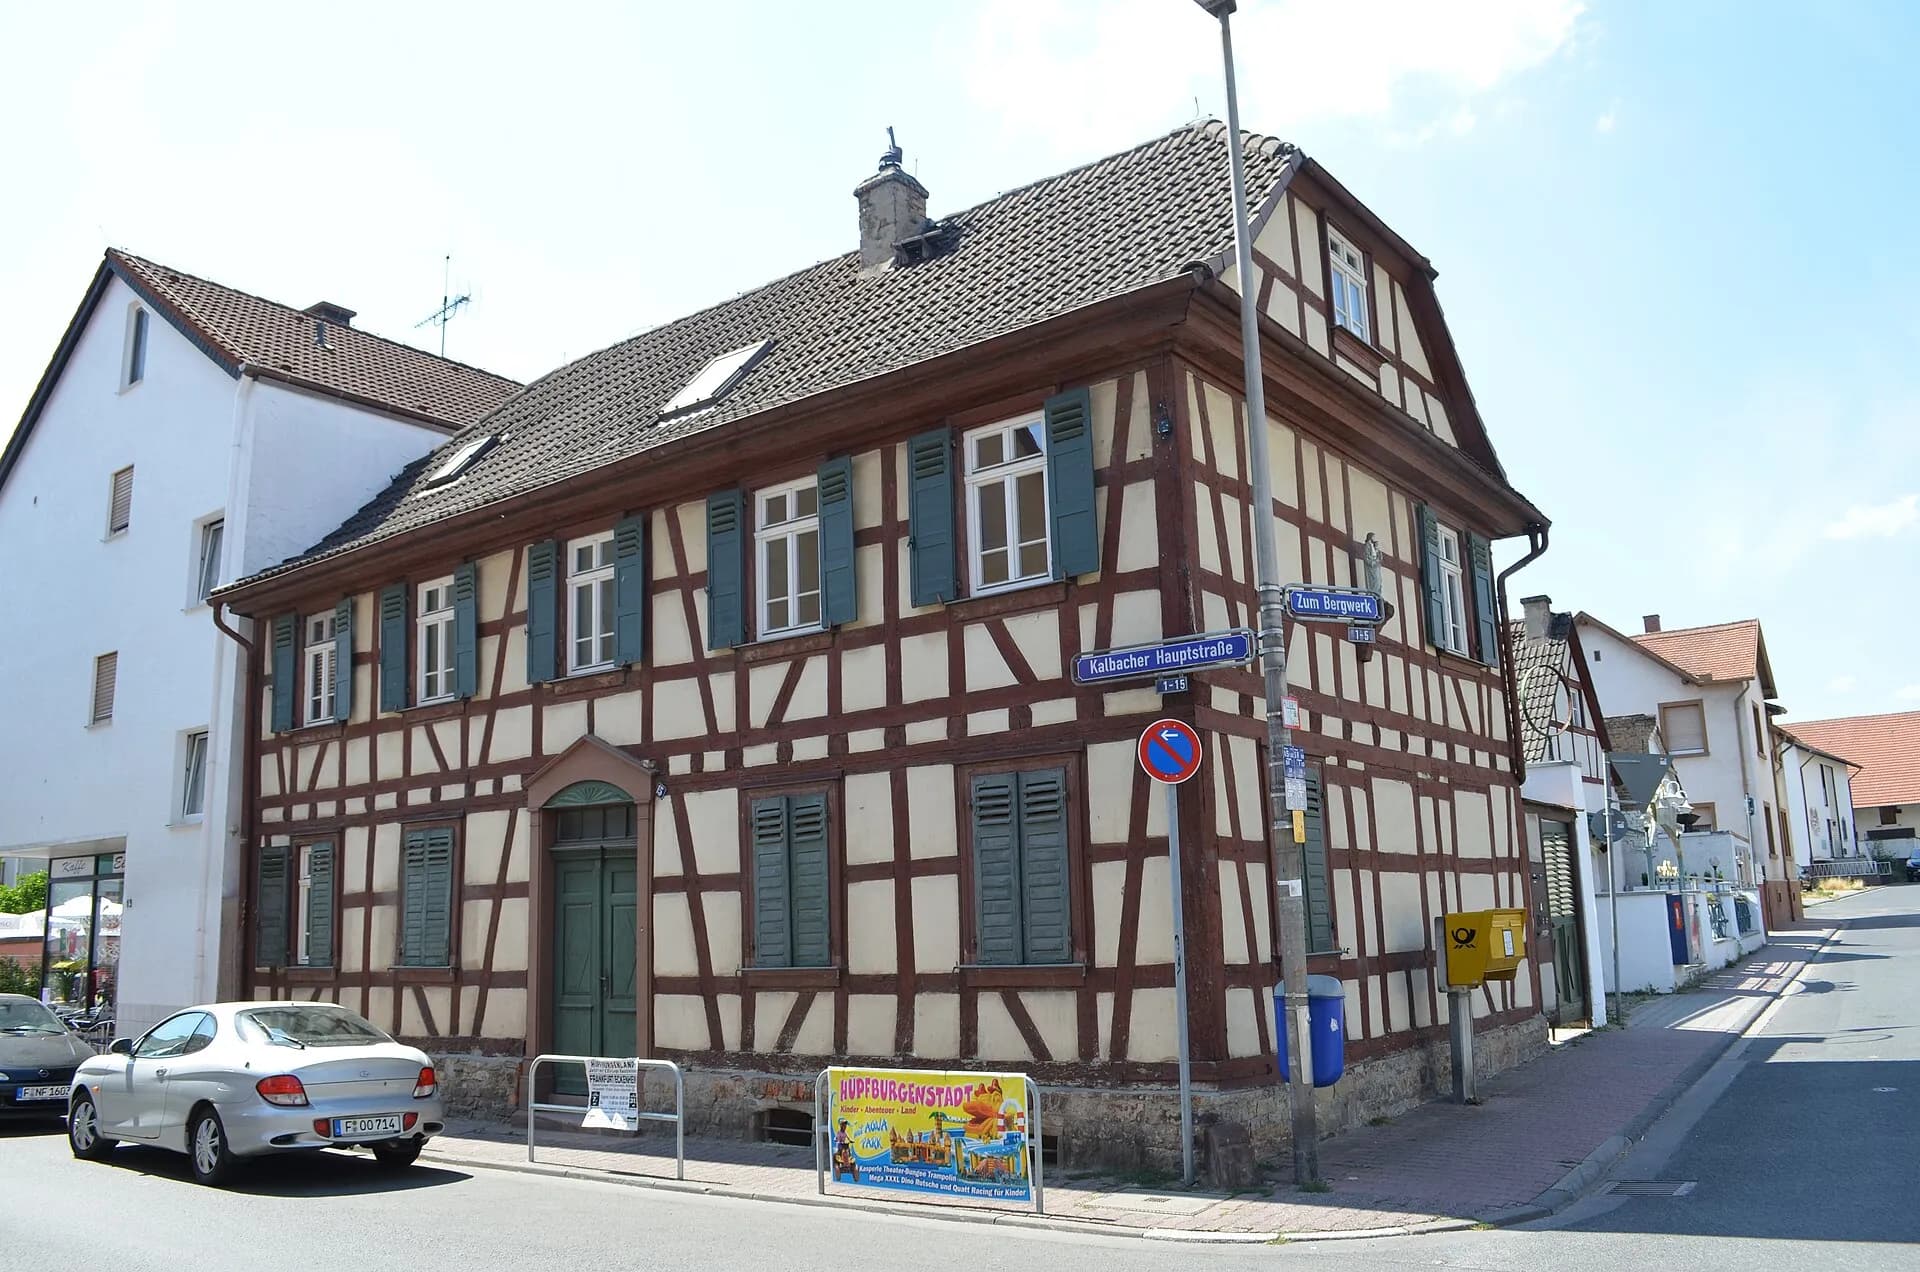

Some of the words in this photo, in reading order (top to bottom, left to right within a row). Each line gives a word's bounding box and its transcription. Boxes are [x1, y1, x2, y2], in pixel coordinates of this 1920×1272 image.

[1296, 593, 1320, 610] Zum
[1323, 595, 1372, 615] Bergwerk
[1355, 630, 1369, 641] 1-5
[1089, 654, 1150, 675] Kalbacher
[1156, 641, 1233, 665] Hauptstraße
[1163, 679, 1185, 691] 1-15
[23, 1088, 30, 1097] F
[35, 1087, 48, 1097] NF
[840, 1075, 974, 1108] HÜPFBURGENSTADT
[840, 1105, 859, 1113] Kinder
[864, 1105, 895, 1114] Abenteuer
[901, 1105, 917, 1114] Land
[345, 1120, 353, 1132] F
[376, 1117, 395, 1130] 714
[864, 1118, 888, 1133] AQUA
[859, 1165, 882, 1173] Kasperle
[928, 1171, 957, 1182] Trampolin
[869, 1174, 883, 1183] Mega
[885, 1175, 900, 1183] XXXL
[901, 1177, 914, 1185] Dino
[915, 1178, 938, 1188] Rutsche
[940, 1183, 952, 1191] und
[971, 1186, 993, 1196] Racing
[994, 1187, 1004, 1196] für
[1005, 1187, 1026, 1197] Kinder
